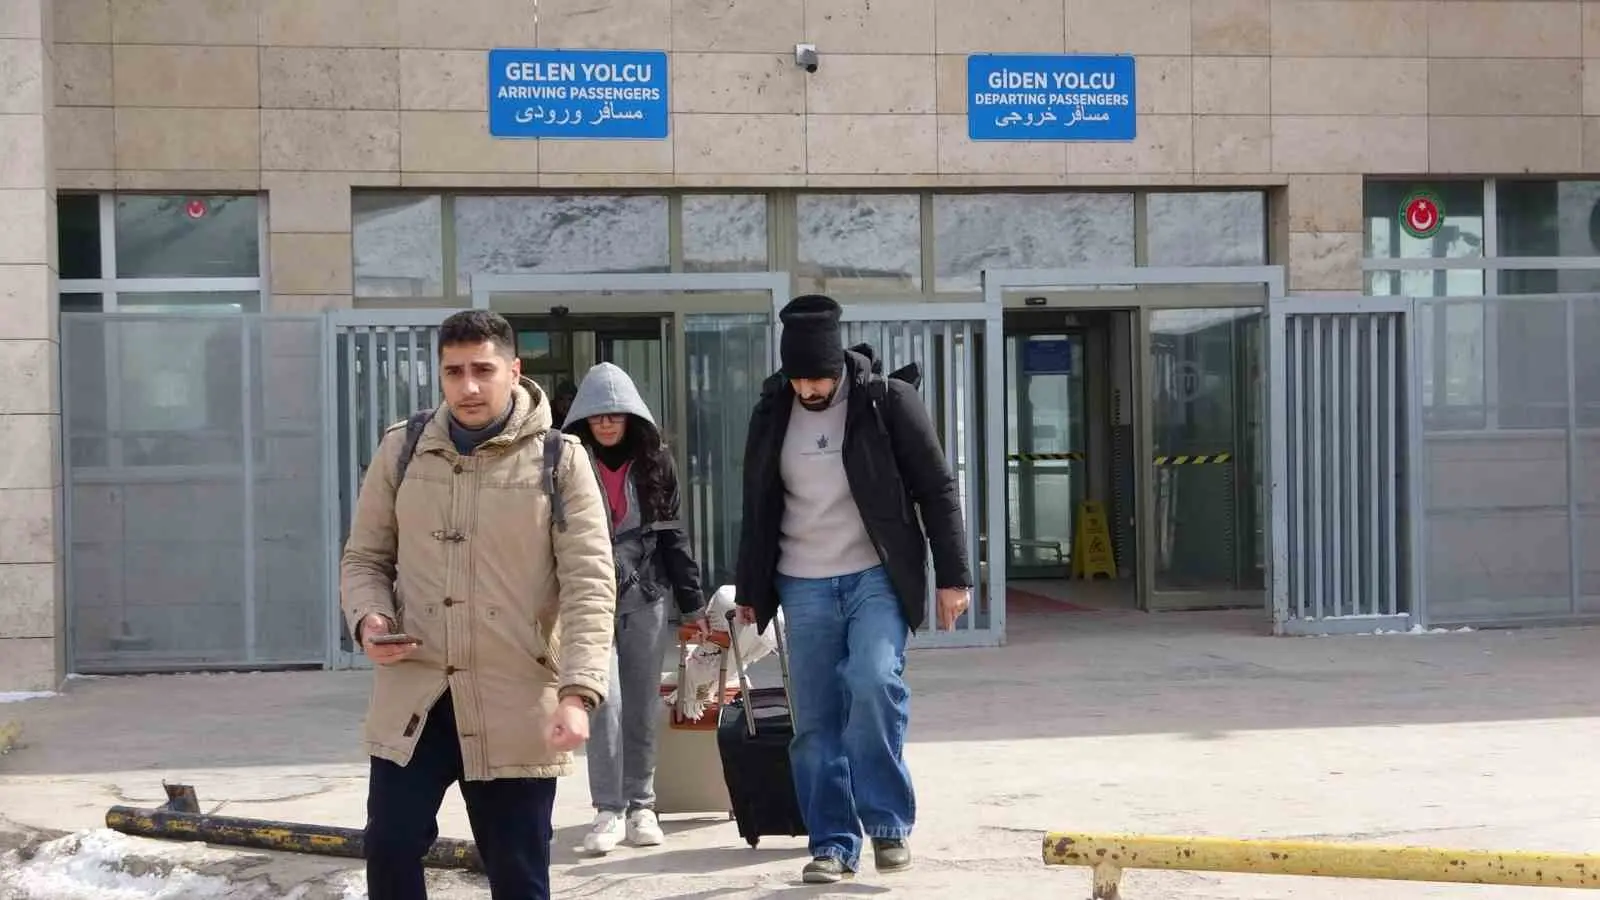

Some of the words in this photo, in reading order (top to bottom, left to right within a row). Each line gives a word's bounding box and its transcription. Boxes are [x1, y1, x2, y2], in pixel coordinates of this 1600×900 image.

[505, 62, 575, 81] GELEN
[580, 63, 651, 82] YOLCU
[988, 68, 1048, 89] GİDEN
[1052, 72, 1115, 89] YOLCU
[498, 86, 567, 99] ARRIVING
[570, 87, 660, 100] PASSENGERS
[975, 93, 1046, 105] DEPARTING
[1049, 94, 1129, 106] PASSENGERS
[514, 104, 582, 125] ورودی
[588, 102, 643, 125] مسافر
[1063, 104, 1110, 127] مسافر
